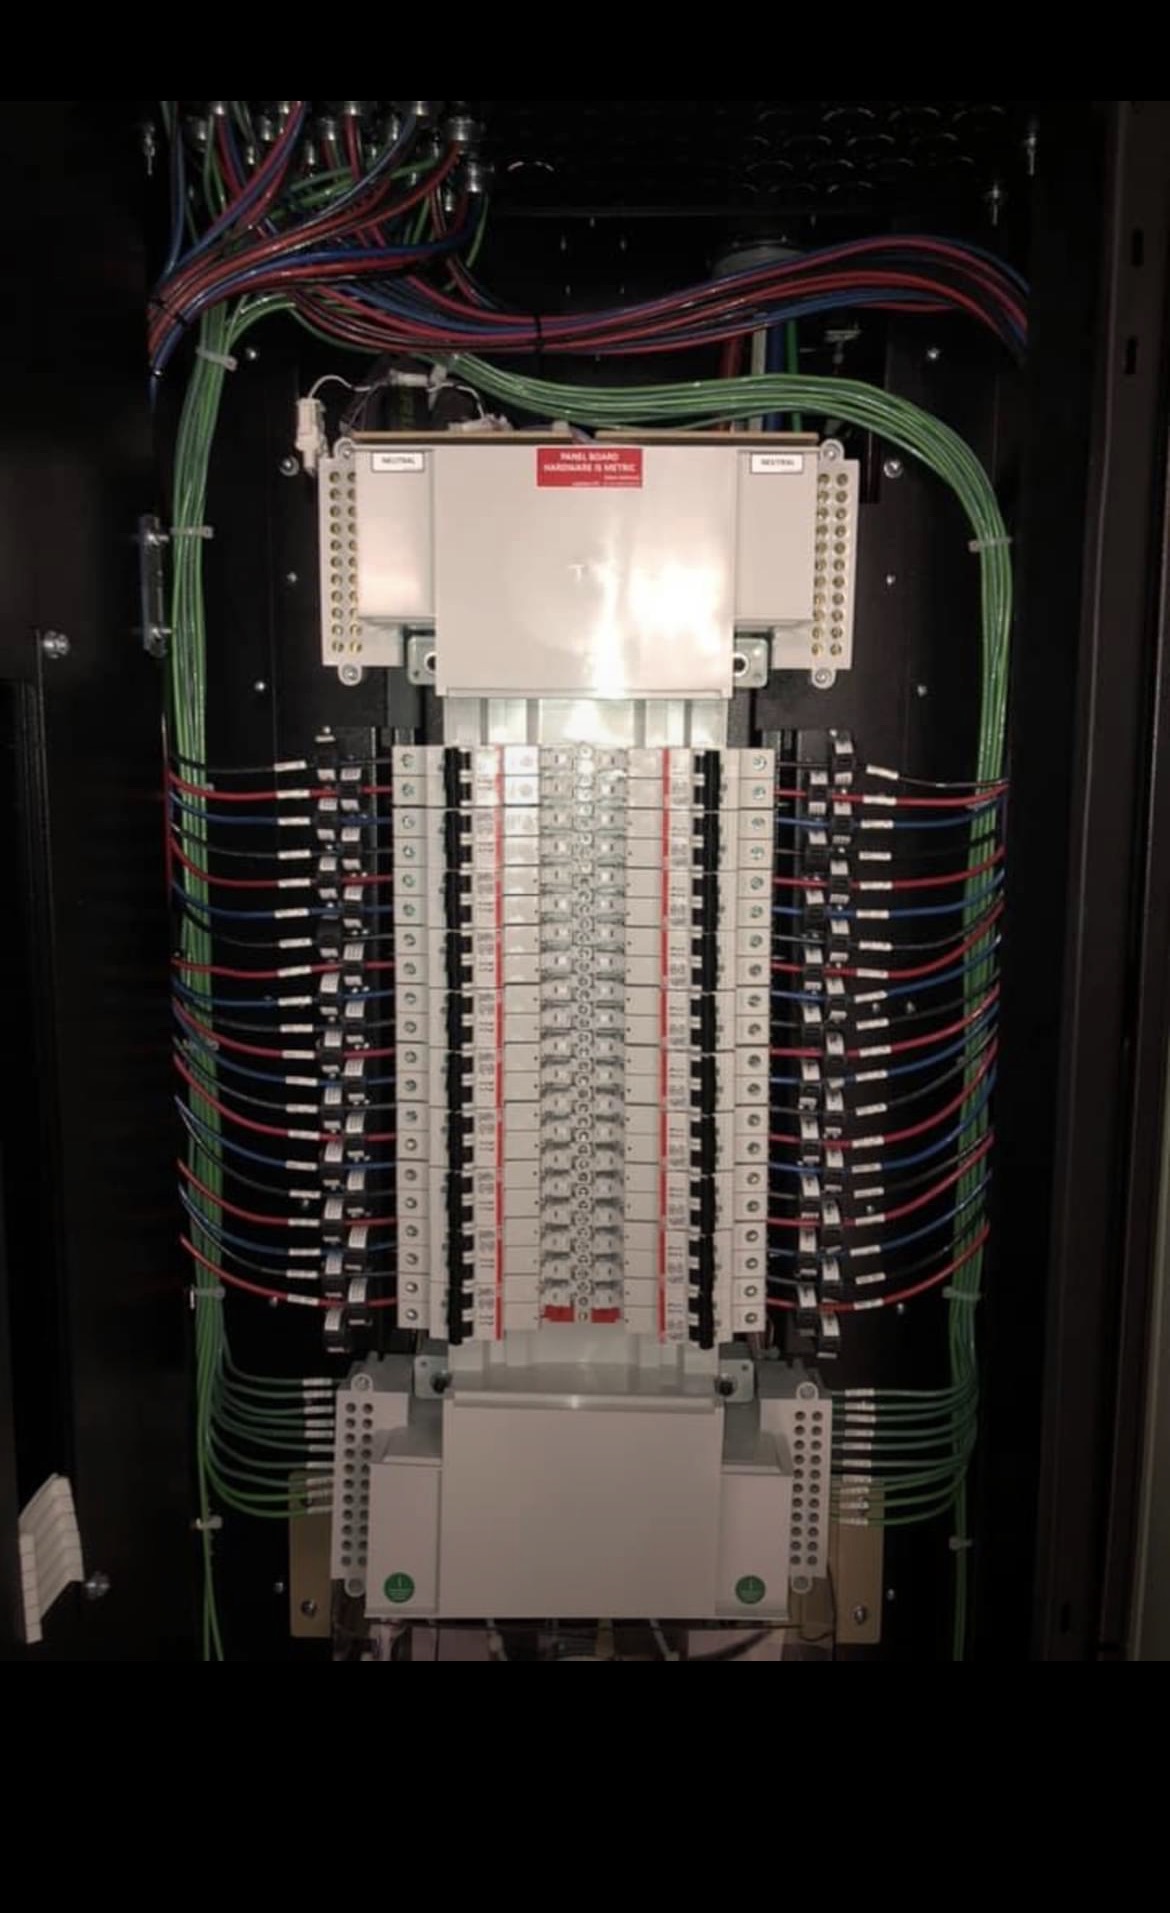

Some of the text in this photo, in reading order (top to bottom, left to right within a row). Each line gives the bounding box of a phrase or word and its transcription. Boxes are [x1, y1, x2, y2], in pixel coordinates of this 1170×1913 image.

[560, 452, 619, 460] PANEL BOARD
[543, 463, 592, 472] HARDWARE
[604, 463, 636, 472] METRIC
